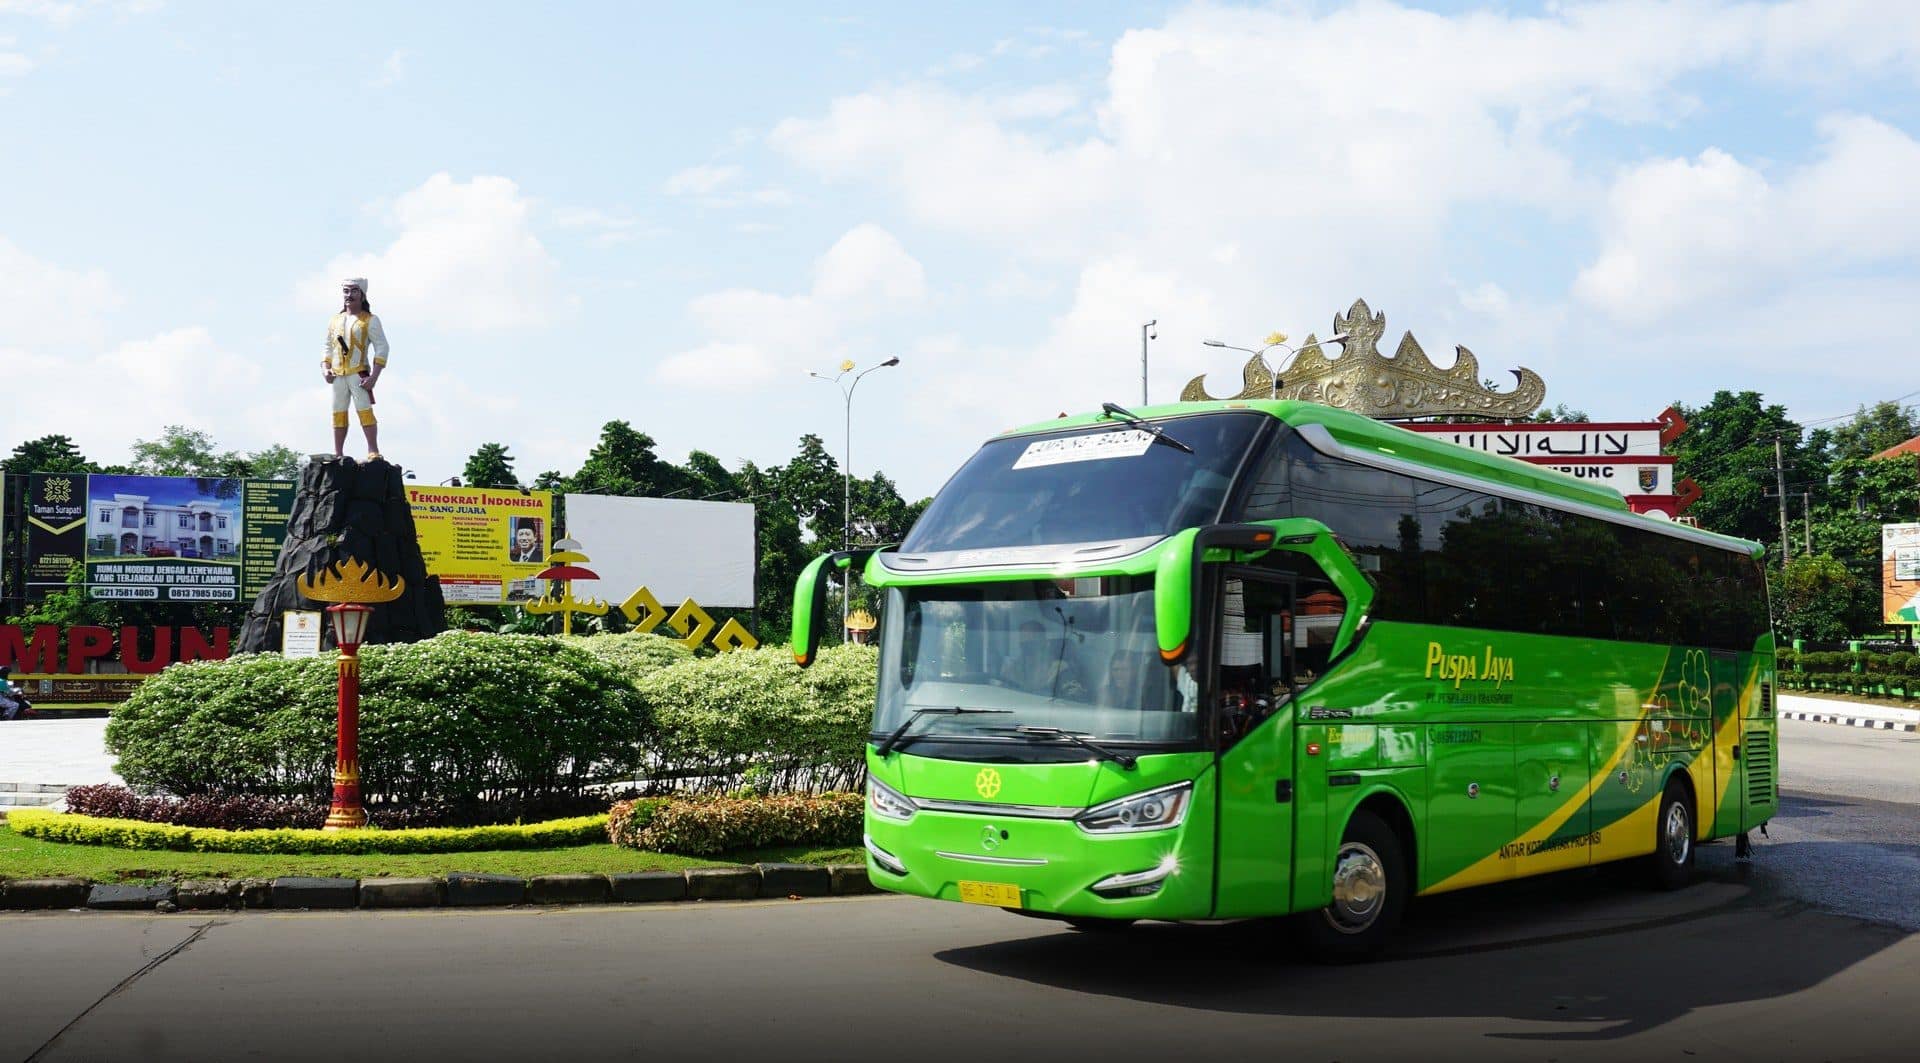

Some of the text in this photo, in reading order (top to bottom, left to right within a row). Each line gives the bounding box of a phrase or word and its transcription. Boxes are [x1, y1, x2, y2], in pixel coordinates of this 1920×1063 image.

[410, 490, 543, 507] TEKNOKRAT INDONESIA
[34, 504, 82, 516] Taman Surapati
[96, 565, 233, 575] RUMAH MODERN DENGAN KEMEWAHAN
[94, 574, 114, 582] YANG
[117, 574, 164, 583] TERJANGKAU
[202, 576, 235, 584] LAMPUNG
[1425, 641, 1513, 690] PUSPA JAYA
[1499, 842, 1525, 859] ANTAR
